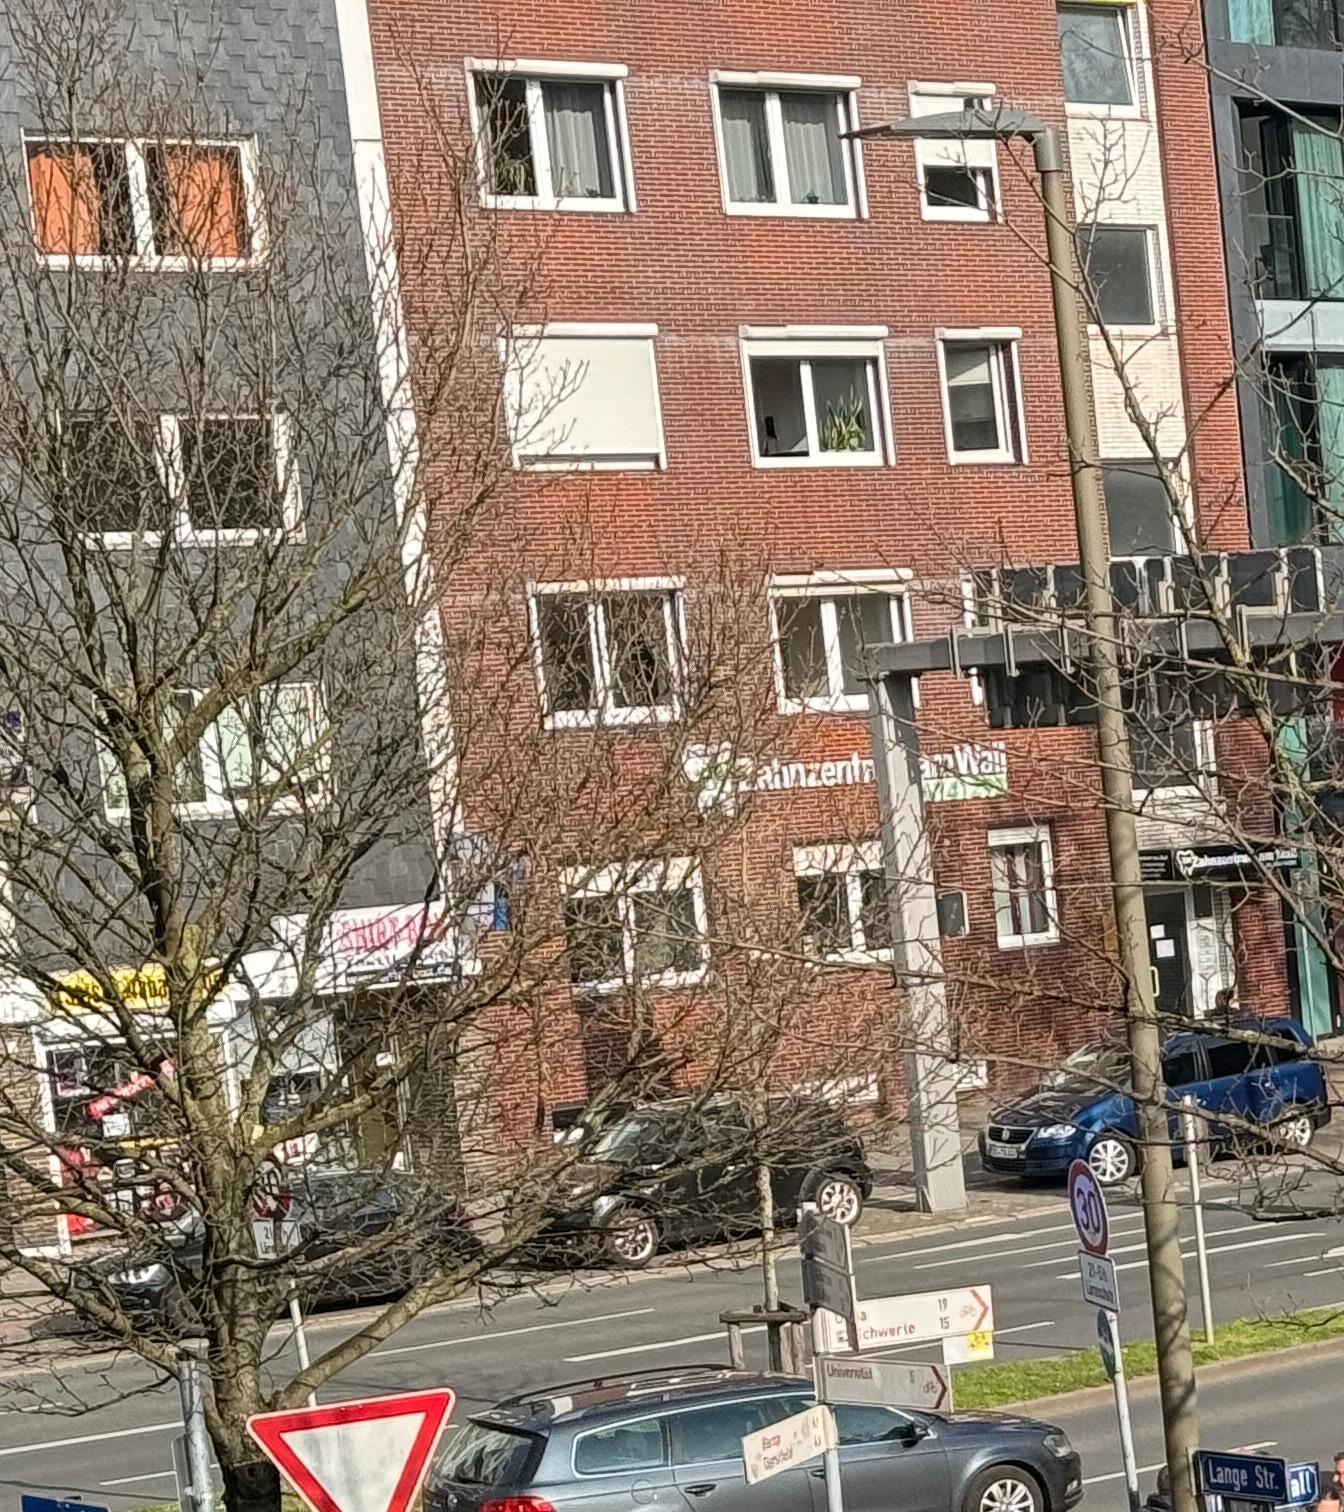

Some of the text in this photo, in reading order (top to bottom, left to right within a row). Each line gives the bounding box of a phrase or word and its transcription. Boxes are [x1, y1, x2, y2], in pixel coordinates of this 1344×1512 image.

[739, 751, 876, 791] Zahnzentr
[952, 741, 1007, 776] Wall
[1076, 1186, 1101, 1234] 30
[937, 1298, 949, 1312] 19
[940, 1316, 951, 1330] 15
[1208, 1458, 1280, 1492] Lange Str.
